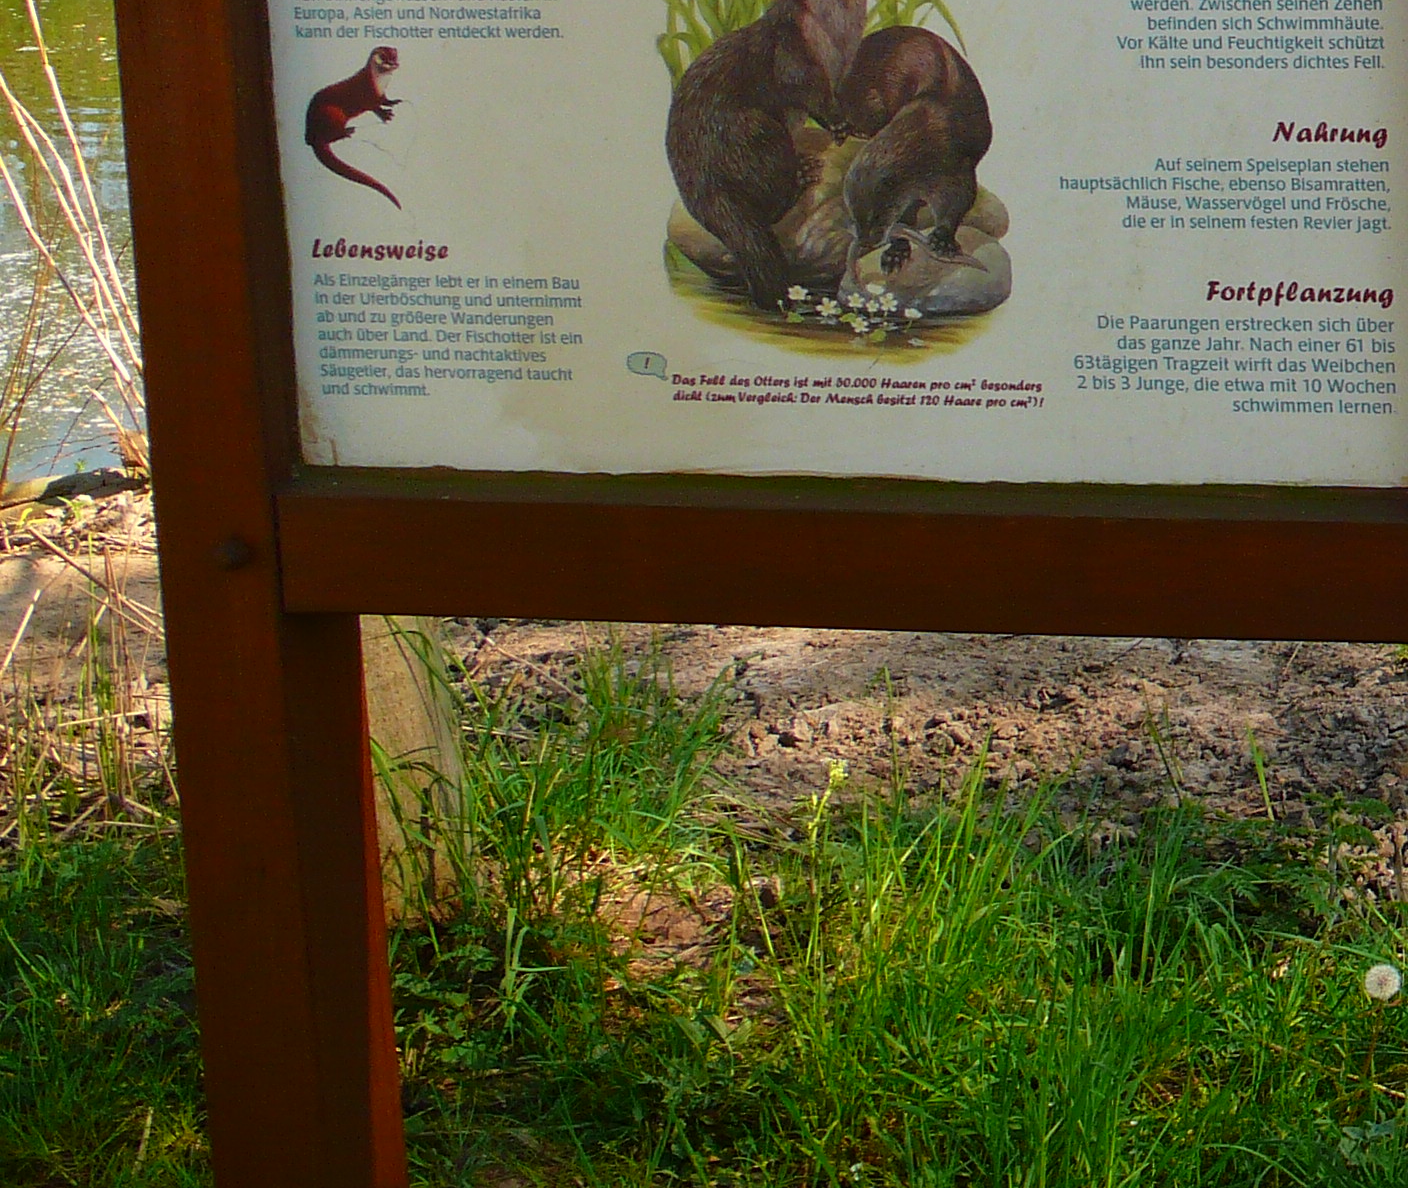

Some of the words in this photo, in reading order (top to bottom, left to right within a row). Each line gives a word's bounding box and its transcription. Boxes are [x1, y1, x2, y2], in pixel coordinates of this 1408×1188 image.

[296, 24, 332, 38] kann
[336, 25, 359, 38] der
[364, 24, 434, 38] Fischotter
[438, 25, 501, 38] entdeckt
[505, 24, 564, 39] werden.
[1148, 15, 1217, 30] befinden
[1222, 16, 1252, 30] sich
[1273, 121, 1387, 148] Nahrung
[1060, 175, 1167, 194] hauptsächlich
[1229, 176, 1286, 191] ebenso
[1291, 177, 1390, 193] Bisamratten,
[1186, 195, 1286, 213] Wasservögel
[1291, 196, 1321, 210] und
[312, 238, 448, 261] Lebensweise
[316, 291, 328, 303] in
[333, 292, 355, 305] der
[360, 291, 461, 309] Uferböschung
[465, 293, 492, 307] und
[496, 294, 582, 308] unternimmt
[1207, 281, 1393, 307] Fortpflanzung
[1097, 314, 1124, 329] Die
[1130, 315, 1219, 334] Paarungen
[1226, 316, 1312, 332] erstrecken
[1318, 316, 1350, 332] sich
[1357, 317, 1394, 333] über
[320, 346, 418, 363] dämmerungs-
[423, 346, 450, 360] und
[454, 348, 546, 362] nachtaktives
[395, 364, 420, 378] das
[424, 365, 523, 382] hervorragend
[527, 367, 573, 381] taucht
[1163, 356, 1229, 375] Tragzeit
[1234, 356, 1272, 371] wirft
[1278, 357, 1306, 372] das
[1312, 357, 1395, 373] Weibchen
[323, 381, 349, 395] und
[672, 373, 696, 386] Das
[729, 374, 750, 387] des
[754, 375, 790, 388] Otters
[794, 376, 808, 388] ist
[812, 376, 832, 388] mit
[881, 378, 926, 389] Haaren
[930, 380, 950, 391] pro
[981, 378, 1042, 391] besonders
[1233, 397, 1333, 413] schwimmen
